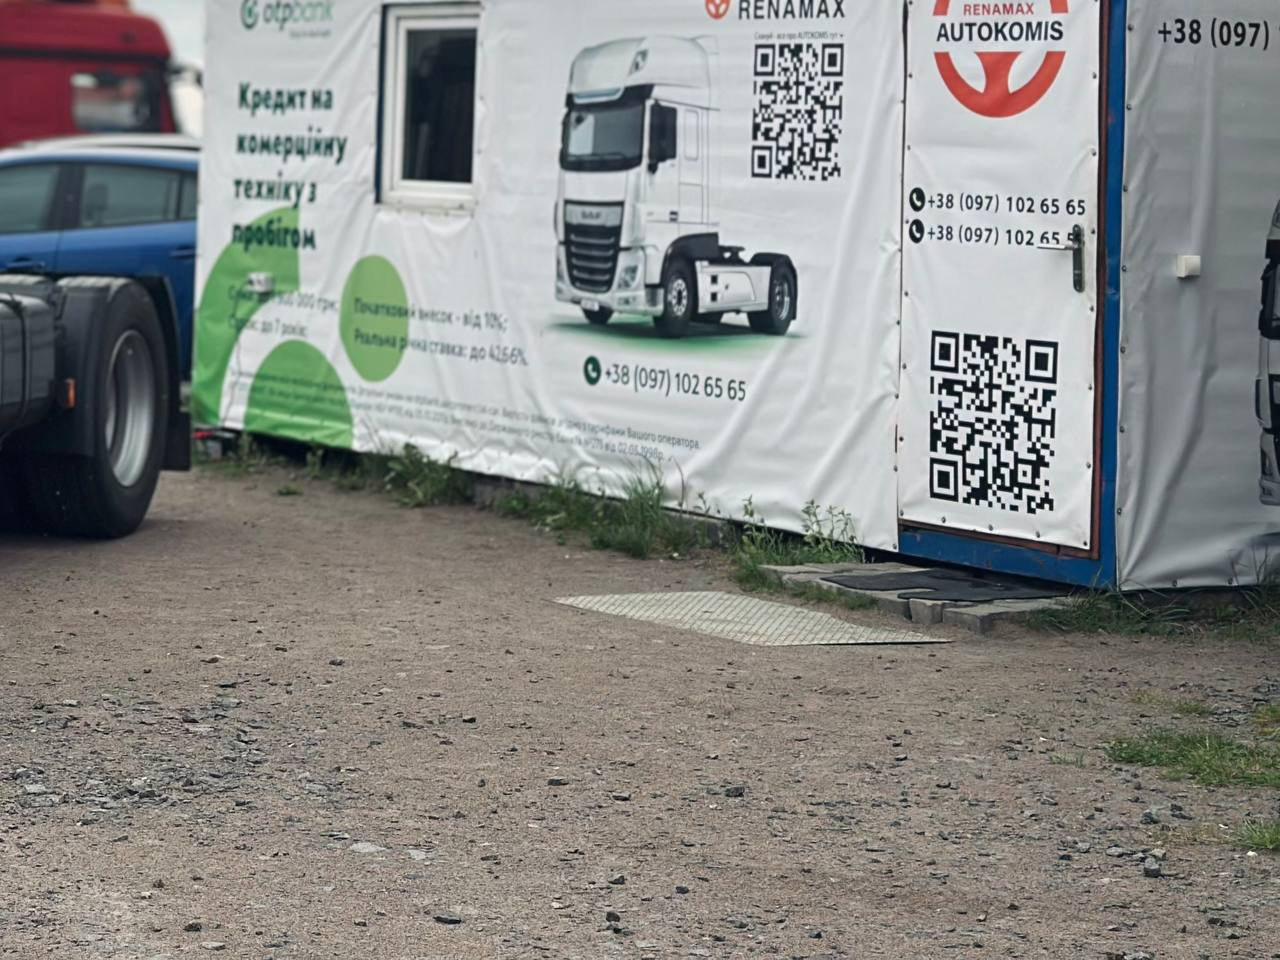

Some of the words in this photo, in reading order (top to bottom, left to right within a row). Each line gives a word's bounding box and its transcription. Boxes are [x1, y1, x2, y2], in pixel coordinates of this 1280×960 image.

[963, 2, 1035, 16] RENAMAX
[936, 20, 1064, 43] AUTOKOMIS
[1158, 18, 1202, 45] +38
[1211, 17, 1270, 51] (097)
[238, 81, 307, 118] Кредит
[311, 89, 333, 110] на
[236, 123, 348, 165] комерційну
[233, 169, 305, 209] техніку
[307, 181, 317, 202] з
[928, 193, 955, 210] +38
[959, 192, 1000, 214] (097)
[1006, 196, 1036, 214] 102
[1040, 198, 1060, 215] 65
[1066, 199, 1086, 216] 65
[231, 215, 316, 253] пробігом
[927, 224, 954, 241] +38
[958, 224, 1000, 246] (097)
[1006, 229, 1035, 246] 102
[1040, 231, 1060, 245] 65
[605, 363, 630, 385] +38
[634, 364, 671, 397] (097)
[674, 372, 700, 395] 102
[704, 376, 723, 398] 65
[727, 379, 747, 402] 65
